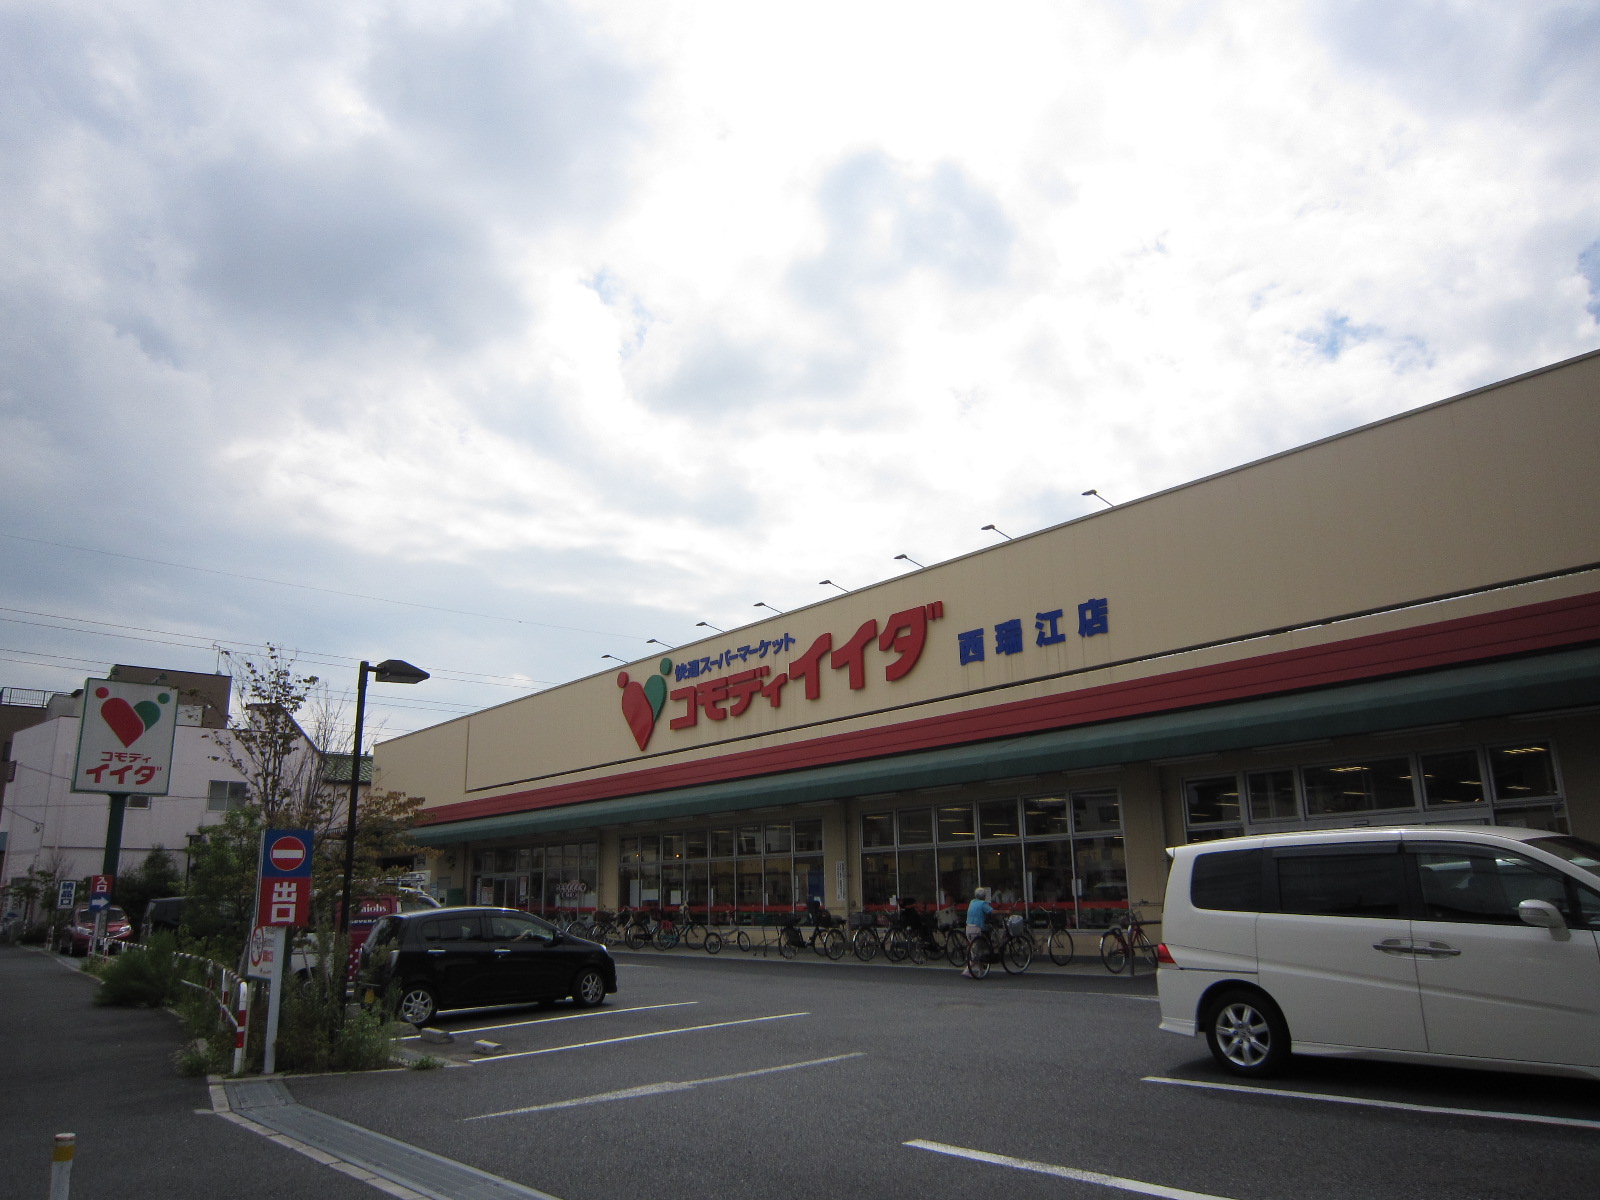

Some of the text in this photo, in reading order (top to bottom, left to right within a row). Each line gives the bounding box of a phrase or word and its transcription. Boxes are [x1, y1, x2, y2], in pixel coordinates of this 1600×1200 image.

[958, 598, 1109, 666] 西瑞江店
[670, 600, 944, 730] コモディイイダ
[675, 633, 795, 682] 快適スーパーマーケット
[101, 751, 152, 764] コモディ
[86, 763, 162, 785] イイダ
[61, 882, 74, 905] 納品口
[96, 876, 108, 892] 入口
[270, 881, 297, 923] 出口
[360, 903, 387, 913] aiohs
